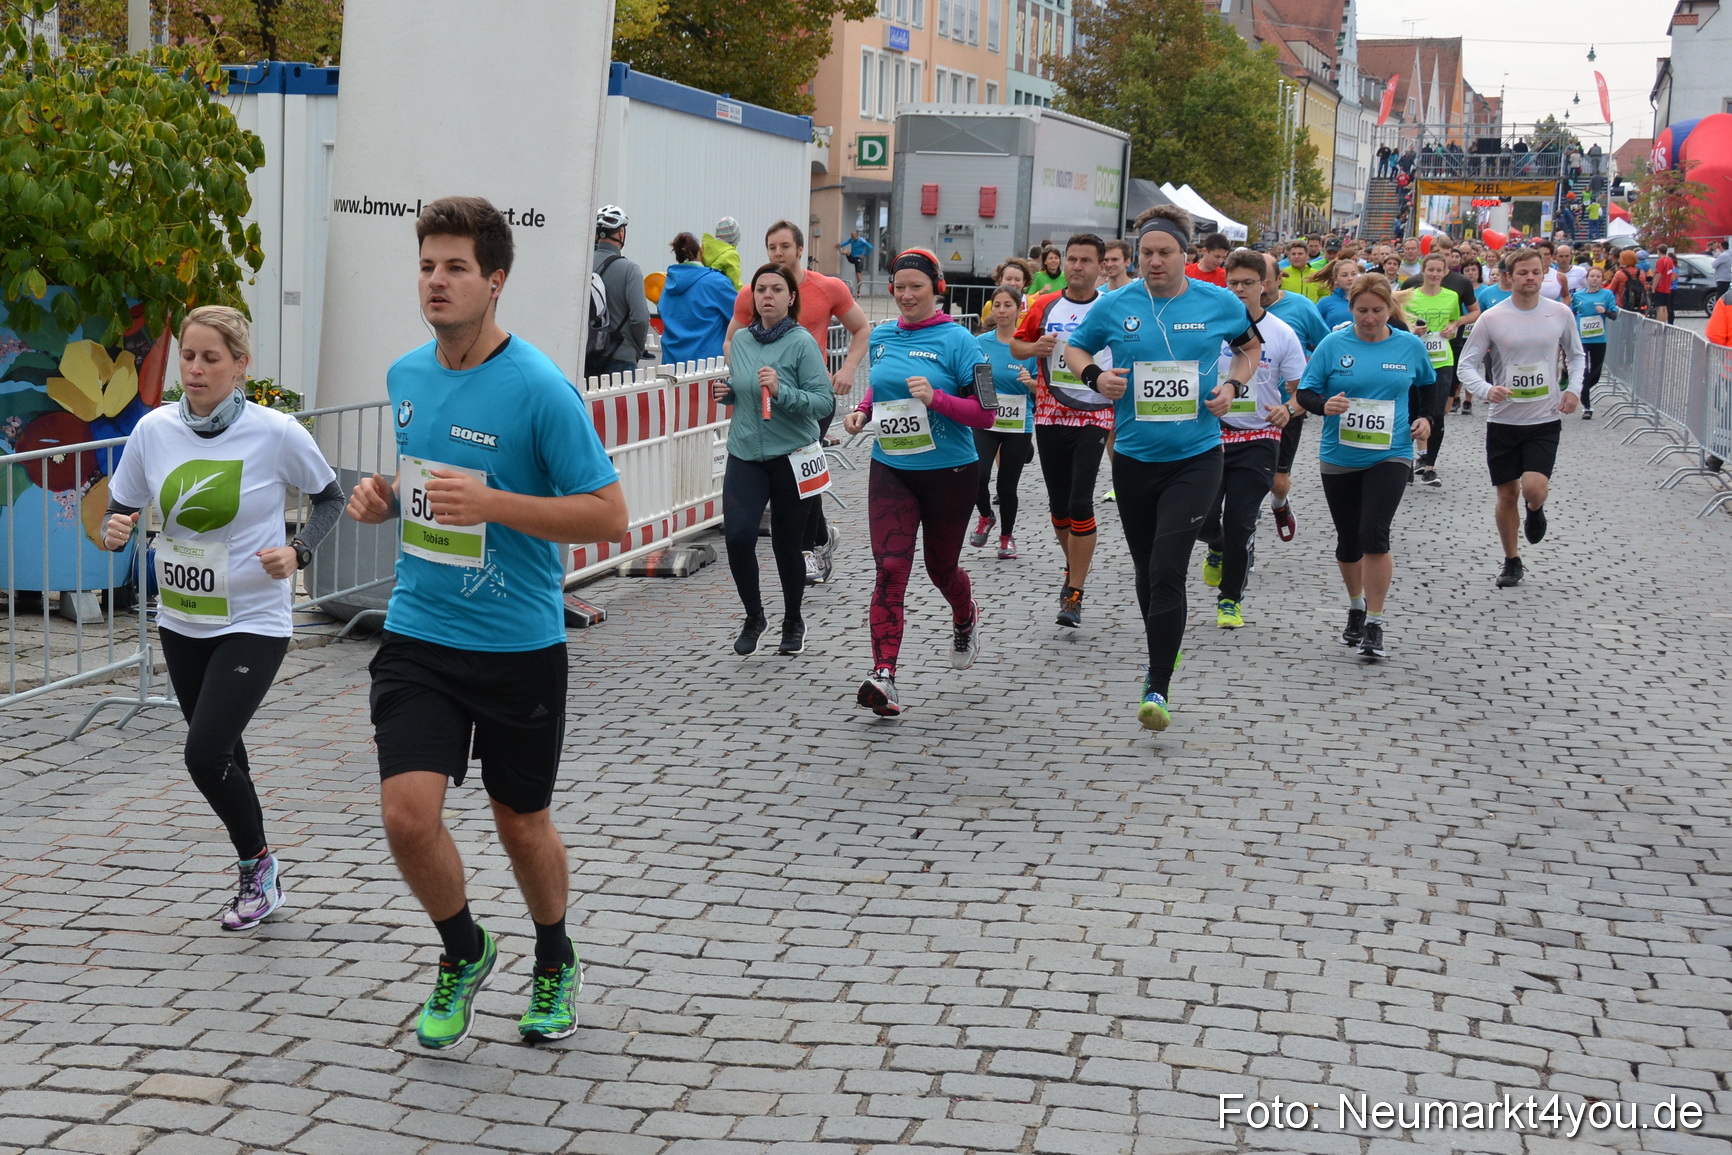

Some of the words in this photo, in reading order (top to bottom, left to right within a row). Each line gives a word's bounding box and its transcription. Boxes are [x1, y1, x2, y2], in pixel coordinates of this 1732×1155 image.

[863, 140, 883, 162] D
[1473, 183, 1503, 194] ZIEL
[333, 195, 545, 227] www.bmw-lt.de
[1173, 322, 1206, 330] BOCK
[1583, 322, 1600, 330] 5022
[1424, 341, 1442, 351] 081
[909, 350, 938, 360] BOCK
[1512, 373, 1544, 388] 5016
[1143, 379, 1190, 398] 5236
[997, 405, 1020, 418] 034
[880, 416, 920, 435] 5235
[1346, 413, 1386, 430] 5165
[450, 424, 499, 448] BOCK
[801, 454, 826, 477] 8000
[422, 531, 450, 546] Tobias
[179, 545, 205, 557] BOCK
[164, 561, 215, 593] 5080
[180, 597, 197, 609] Julia
